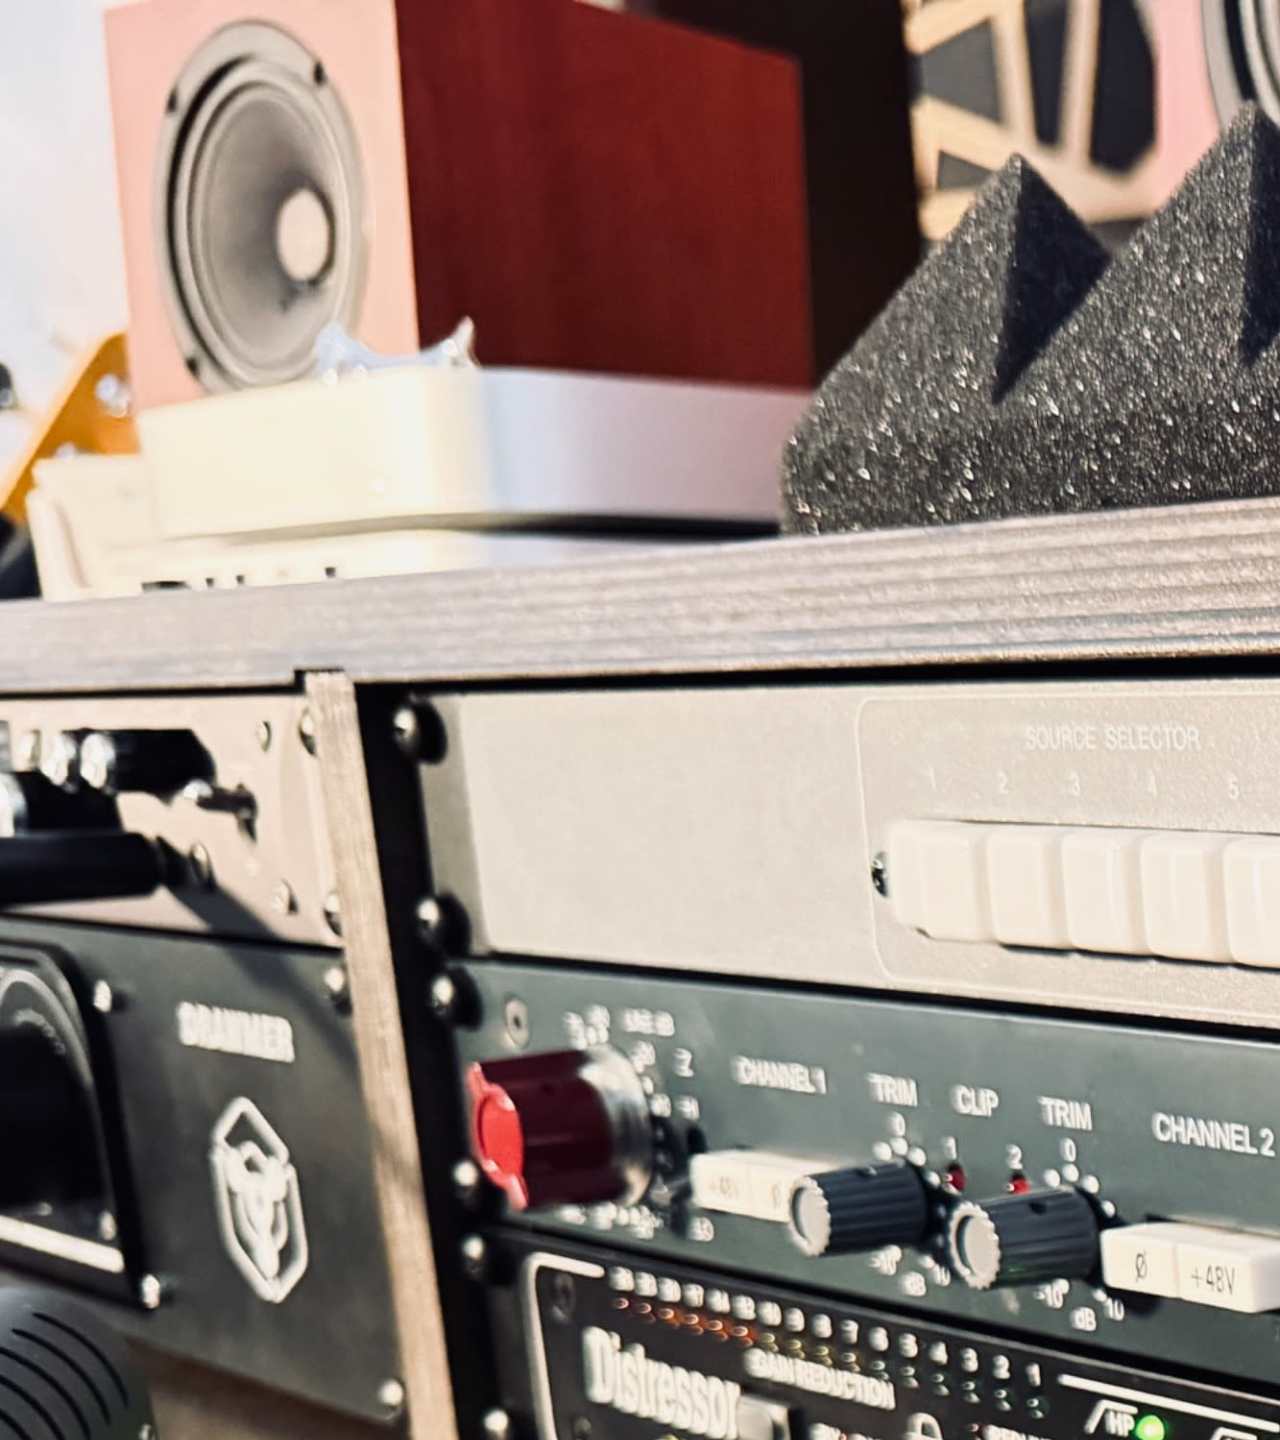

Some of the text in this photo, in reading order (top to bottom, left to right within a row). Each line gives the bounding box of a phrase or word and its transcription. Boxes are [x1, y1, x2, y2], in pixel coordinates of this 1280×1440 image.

[1025, 725, 1201, 753] SOURCE SELECTOR
[732, 1055, 812, 1093] CHANNEL
[866, 1072, 918, 1107] TRIM
[952, 1084, 999, 1117] CLIP
[1038, 1096, 1092, 1131] TRIM
[1152, 1112, 1276, 1157] CHANNEL 2
[1006, 1144, 1023, 1169] 2
[1189, 1267, 1238, 1295] +48V
[1104, 1410, 1136, 1438] HP
